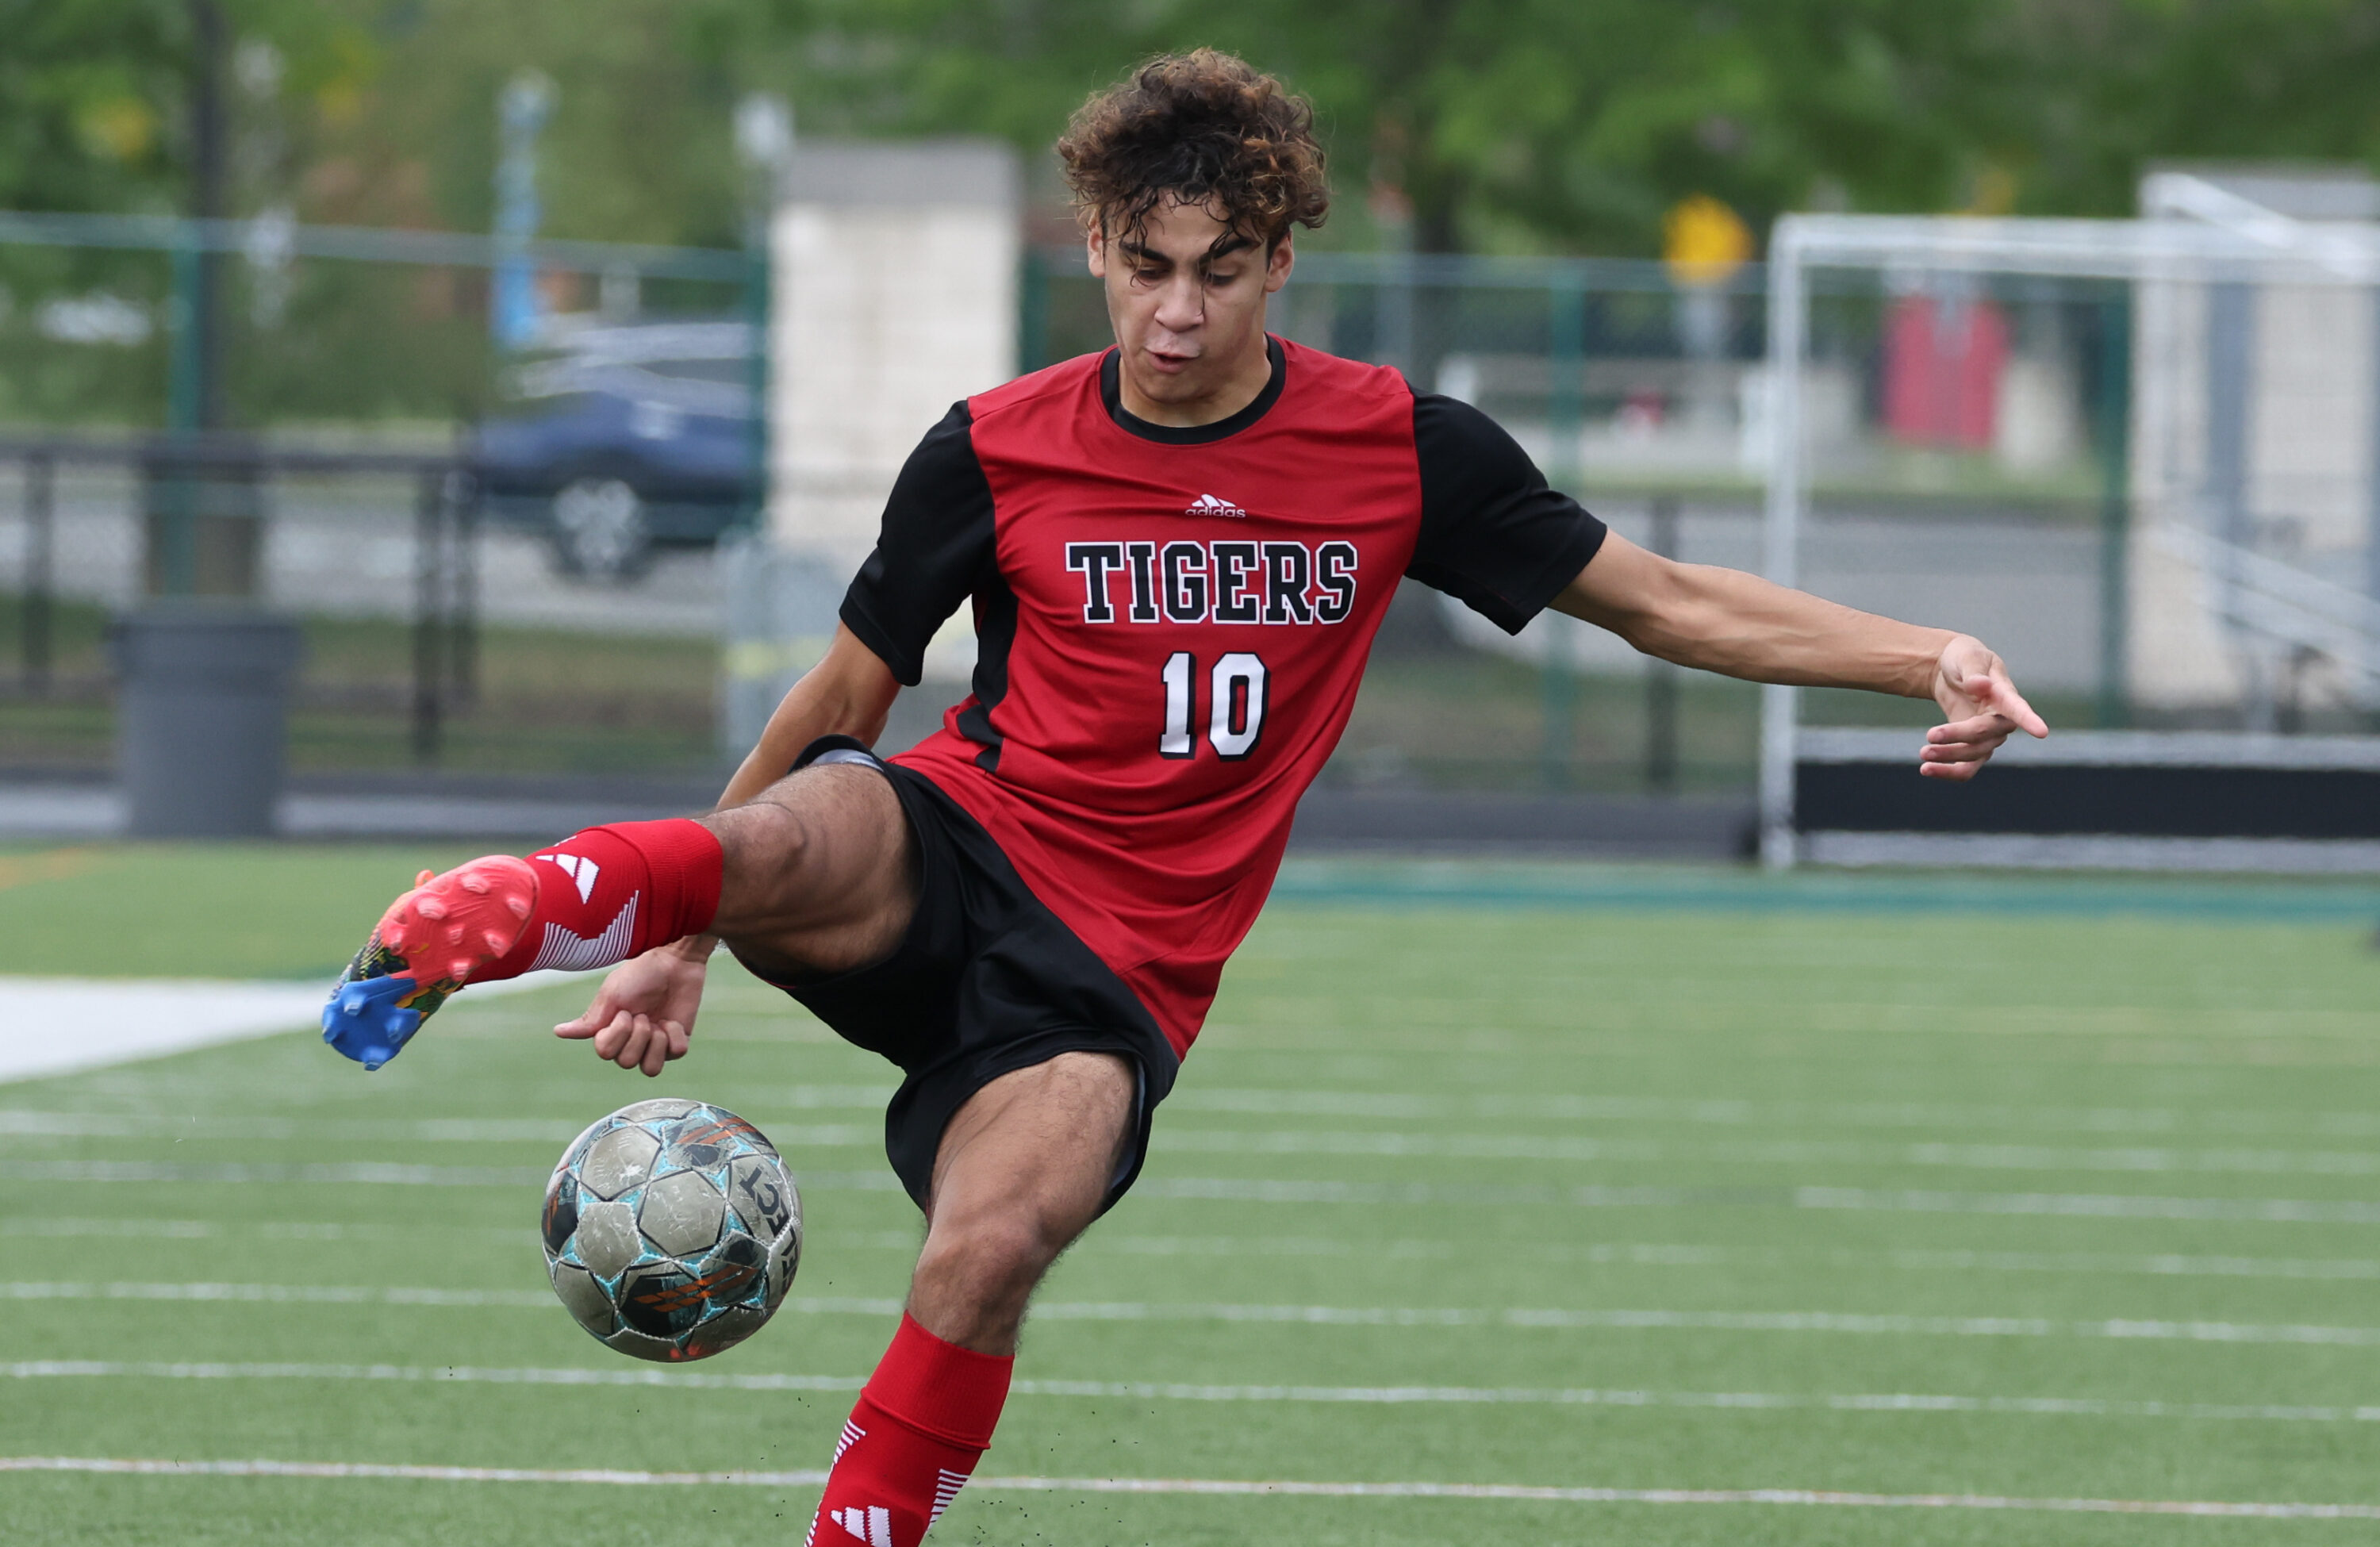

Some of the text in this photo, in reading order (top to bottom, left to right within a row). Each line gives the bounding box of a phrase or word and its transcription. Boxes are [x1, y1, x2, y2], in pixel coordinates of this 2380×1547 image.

[1185, 505, 1246, 518] adidas
[1065, 541, 1357, 625] TIGERS
[1158, 651, 1271, 762] 10
